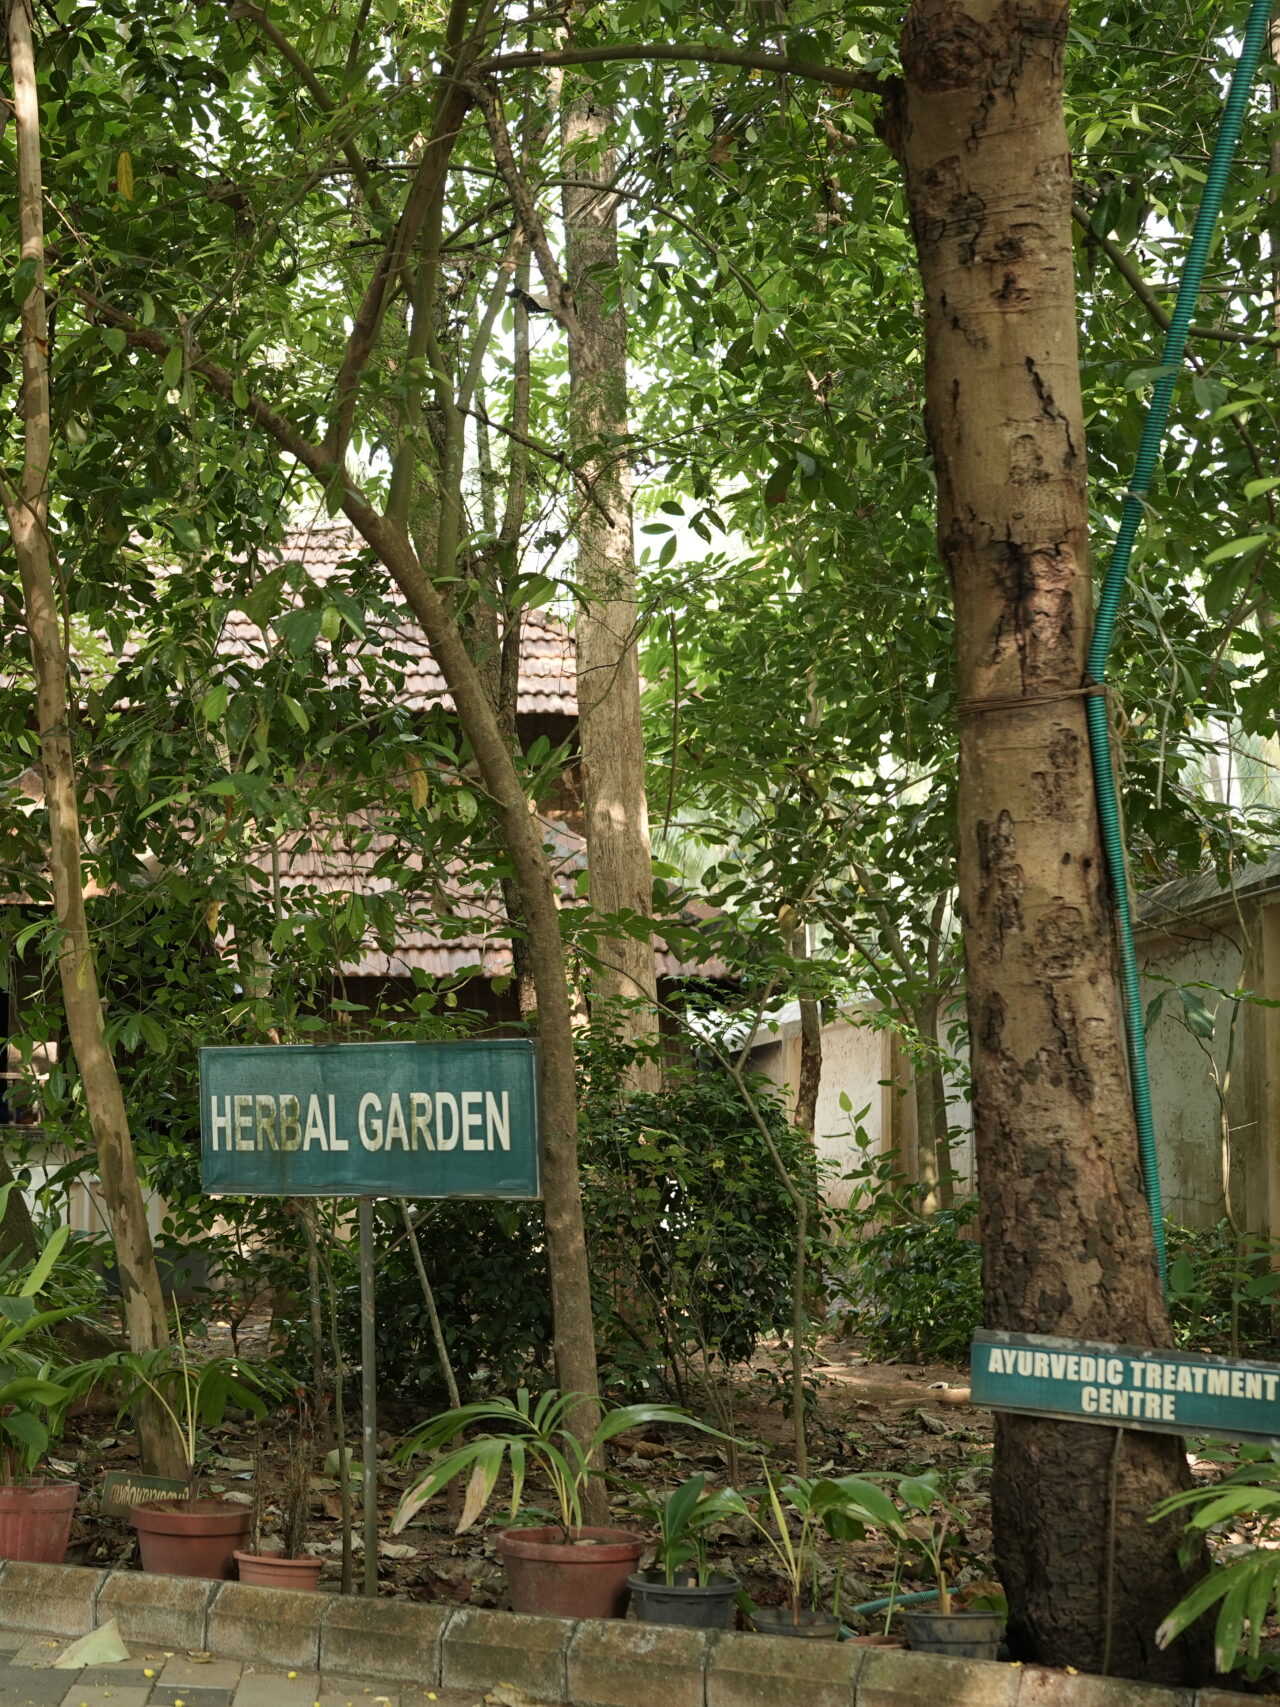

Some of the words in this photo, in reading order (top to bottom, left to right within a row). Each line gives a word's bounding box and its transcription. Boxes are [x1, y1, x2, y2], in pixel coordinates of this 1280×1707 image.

[211, 1093, 349, 1151] HERBAL
[358, 1091, 511, 1152] GARDEN
[988, 1347, 1124, 1386] AYURVEDIC
[1130, 1360, 1279, 1401] TREATMENT
[1081, 1386, 1176, 1421] CENTRE
